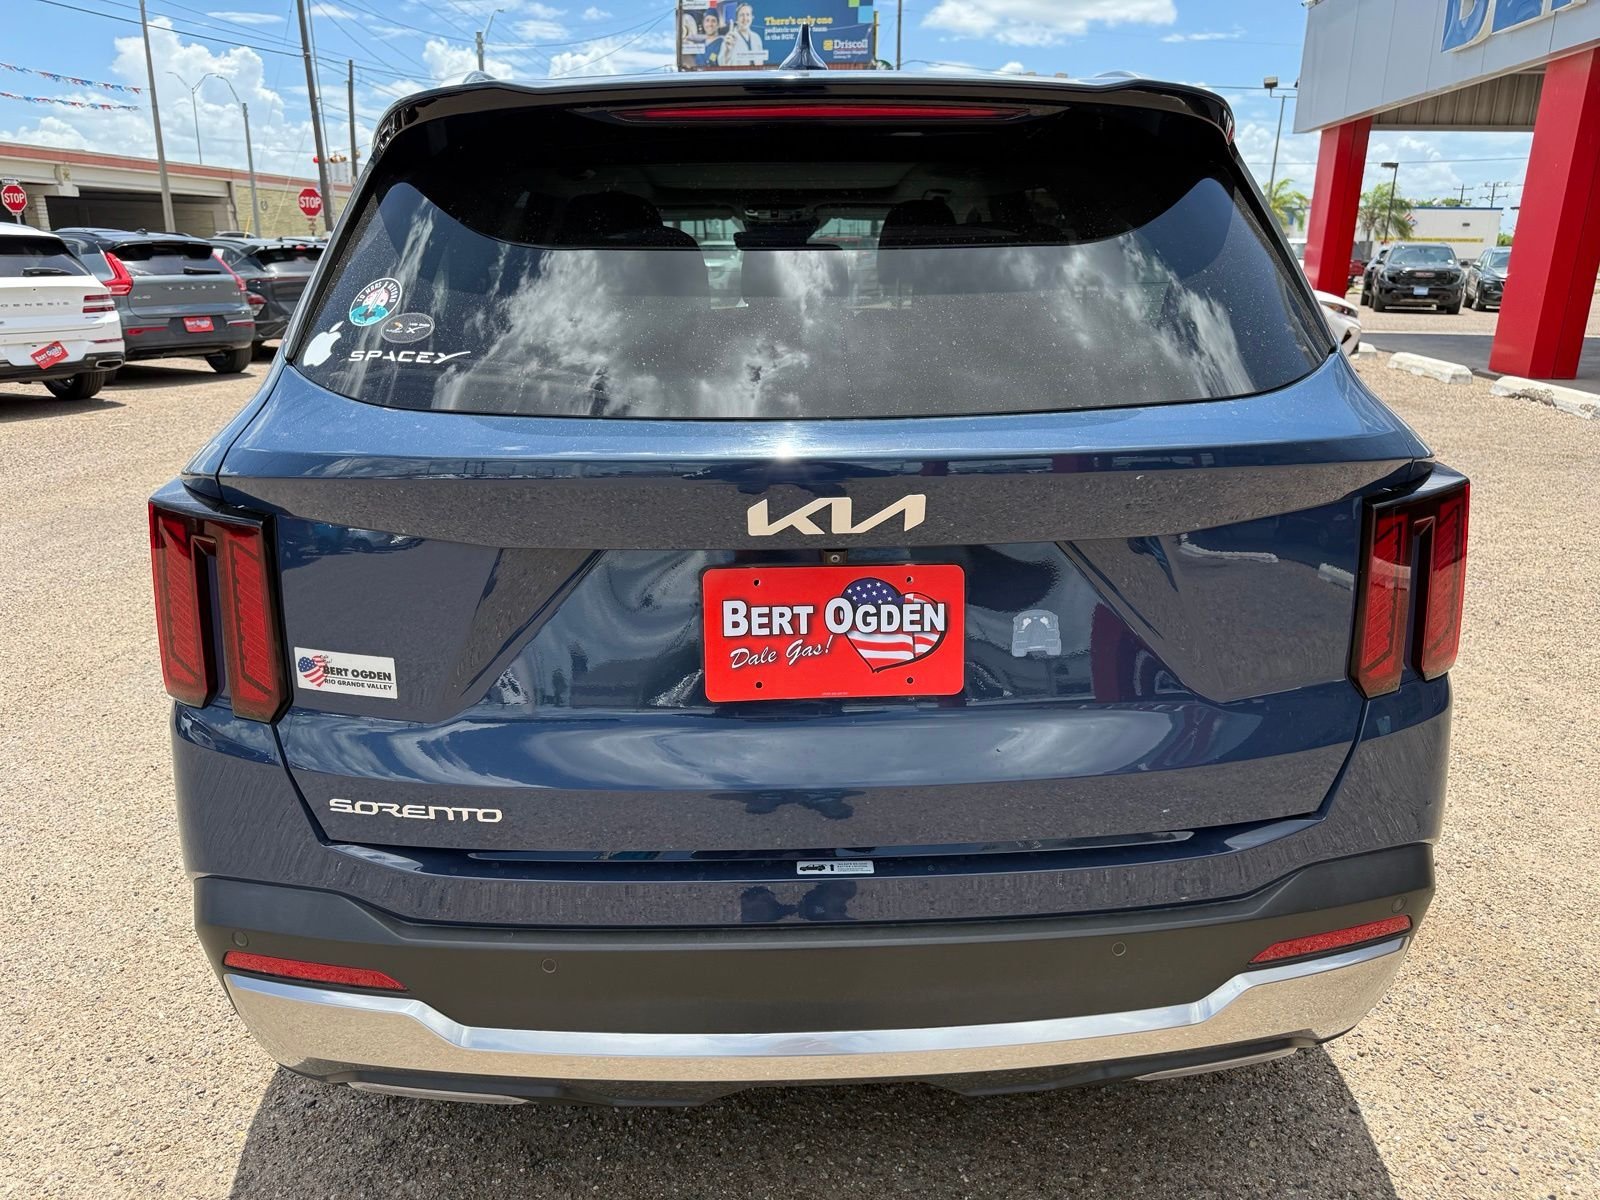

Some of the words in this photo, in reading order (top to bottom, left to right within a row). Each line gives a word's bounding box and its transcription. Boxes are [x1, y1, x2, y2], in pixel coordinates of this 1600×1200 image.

[764, 16, 796, 25] There's
[797, 15, 815, 26] only
[833, 39, 868, 49] Driscoll
[4, 193, 25, 204] STOP
[299, 196, 321, 209] STOP
[365, 281, 383, 294] MARS
[747, 494, 926, 536] KIA
[722, 599, 814, 637] BERT
[824, 597, 946, 635] OGDEN
[729, 646, 778, 669] Dale
[785, 635, 833, 666] Gas!
[323, 666, 350, 677] BERT
[351, 669, 392, 682] OGDEN
[337, 679, 365, 688] GRANDE
[366, 683, 392, 691] VALLEY
[329, 798, 503, 823] SORENTO
